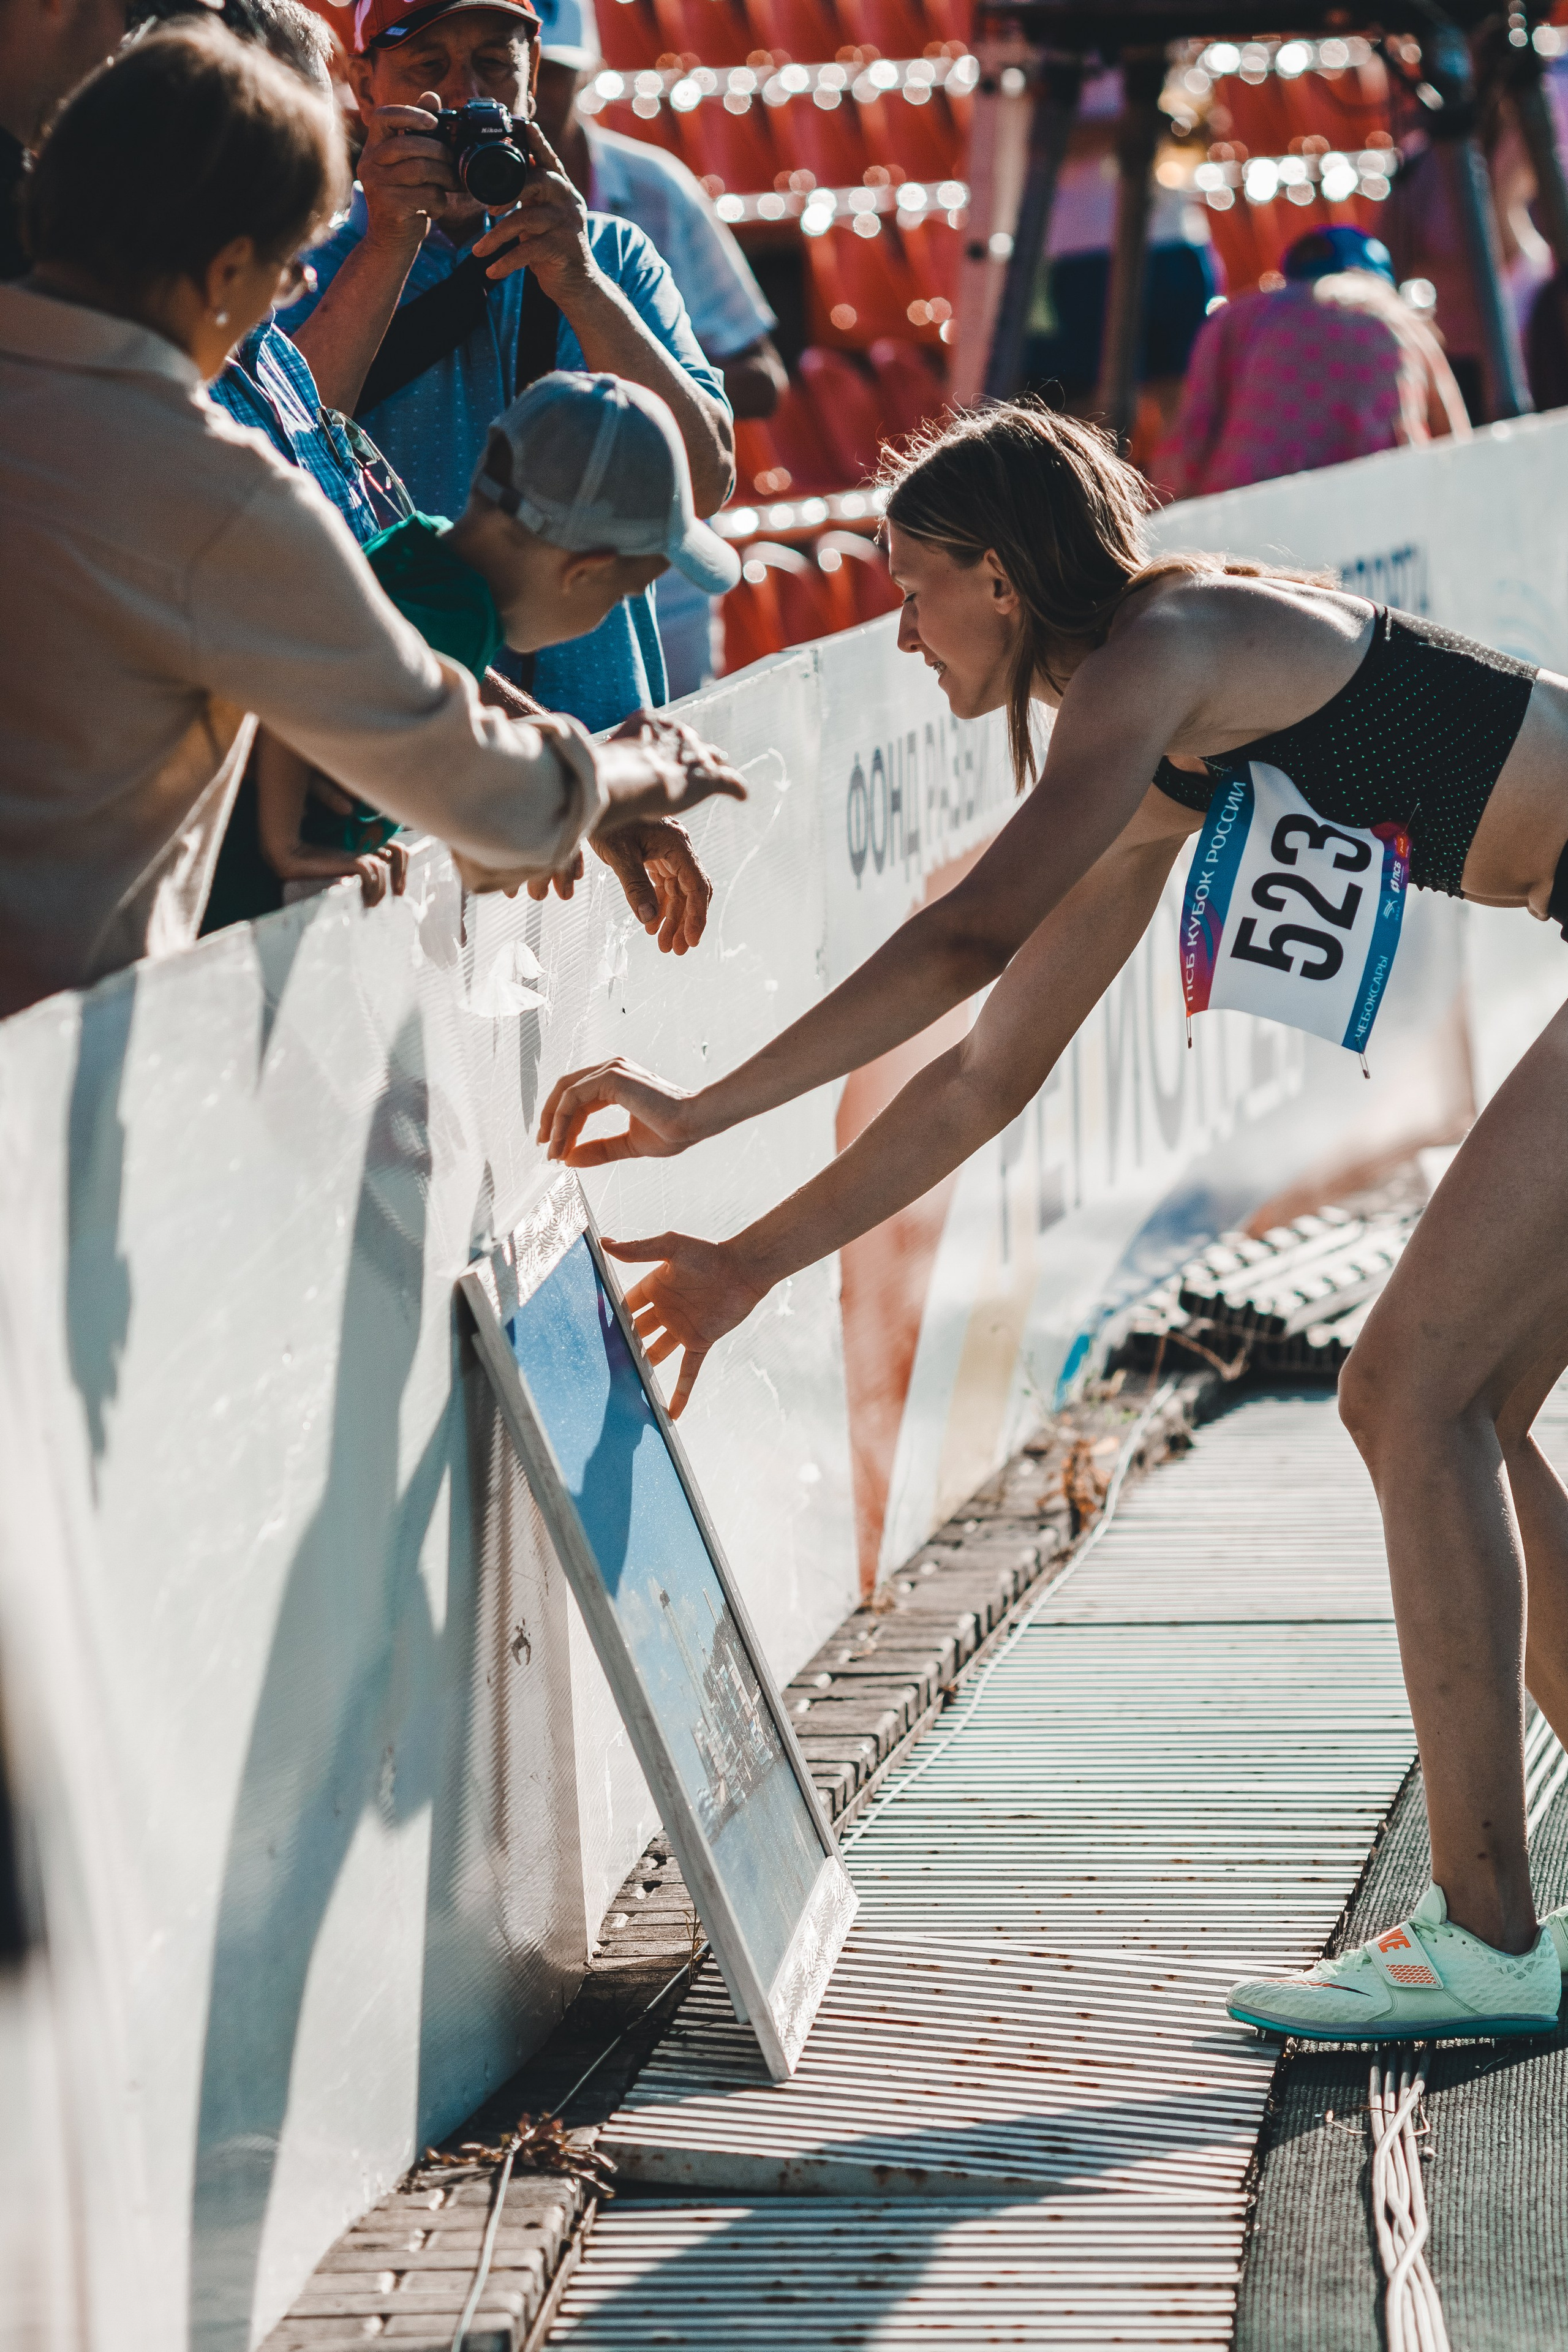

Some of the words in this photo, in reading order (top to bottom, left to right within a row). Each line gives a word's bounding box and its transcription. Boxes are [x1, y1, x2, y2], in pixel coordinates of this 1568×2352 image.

[1205, 780, 1246, 864] РОССИИ
[1188, 870, 1215, 947] КУБОК
[1230, 813, 1372, 981] 523
[1392, 860, 1401, 881] ПСБ
[1186, 952, 1196, 1001] ПСБ
[1355, 955, 1389, 1038] ЧЕБОКСАРЫ
